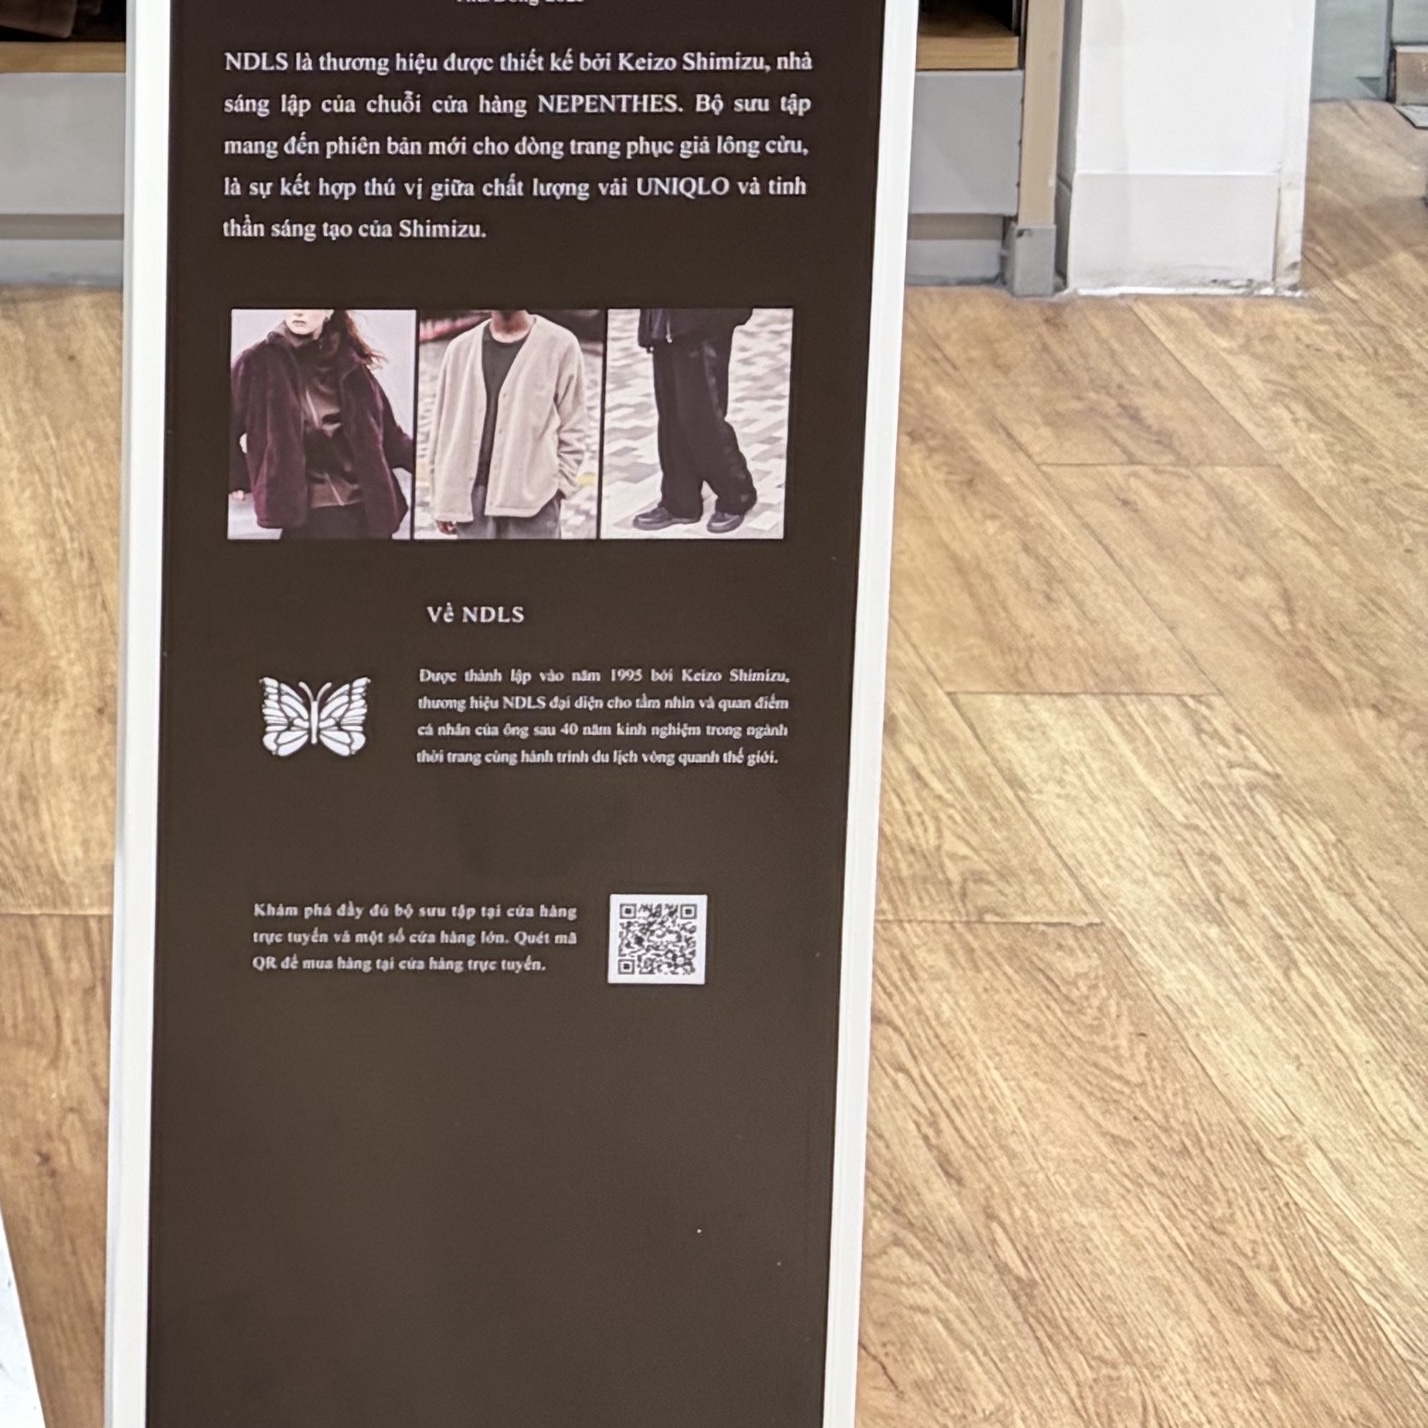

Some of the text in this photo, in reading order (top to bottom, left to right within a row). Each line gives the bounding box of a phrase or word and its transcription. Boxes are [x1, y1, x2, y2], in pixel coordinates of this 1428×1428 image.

[224, 47, 813, 76] NDLS là thương hiệu được thiết kế bởi Keizo Shimizu, nhà
[224, 90, 812, 118] sáng lập của chuỗi cửa hàng NEPENTHES. Bộ sưu tập
[224, 131, 809, 160] mang đến phiên bản mới cho dòng trang phục giả lông cừu,
[224, 172, 807, 201] là sự kết hợp thú vị giữa chất lượng vải UNIQLO và tinh
[222, 213, 487, 242] thần sáng tạo của Shimizu.
[426, 602, 525, 623] Về NDLS
[464, 668, 503, 682] thành
[510, 668, 532, 686] lập
[539, 668, 565, 682] vào
[571, 669, 601, 682] năm
[611, 668, 643, 682] 1995
[650, 668, 674, 682] bởi
[681, 668, 723, 682] Keizo
